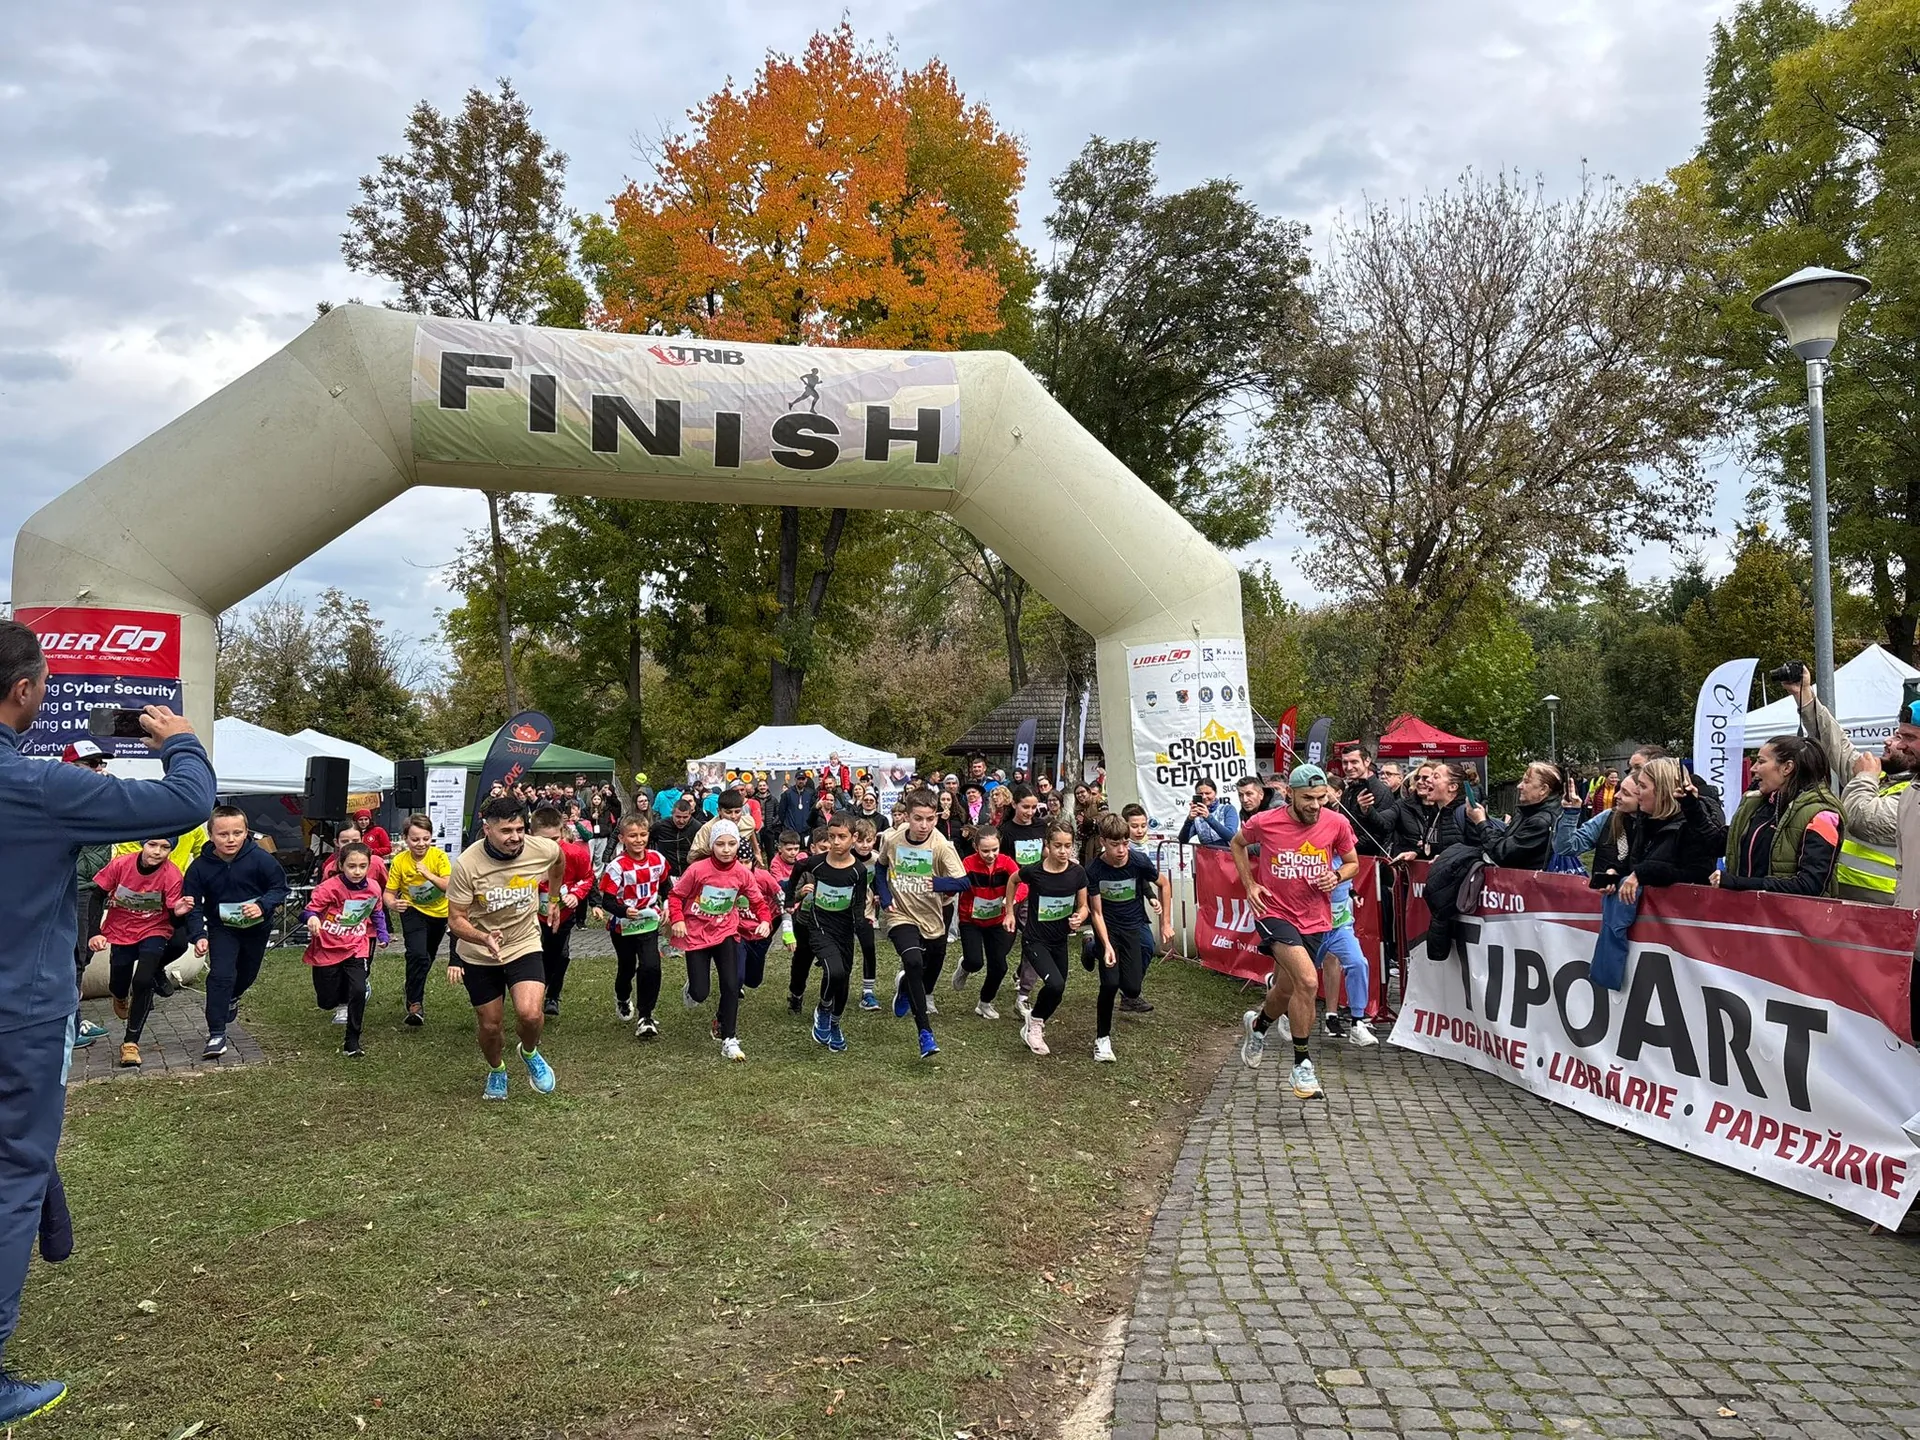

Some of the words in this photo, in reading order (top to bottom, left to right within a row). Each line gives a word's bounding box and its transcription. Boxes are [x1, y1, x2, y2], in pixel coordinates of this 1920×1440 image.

[674, 346, 745, 366] TRIB
[438, 350, 942, 471] FINISH
[37, 633, 101, 651] IDER
[1133, 655, 1167, 666] LIDER
[63, 682, 110, 696] Cyber
[114, 683, 176, 700] Security
[39, 701, 59, 715] ing
[62, 702, 72, 711] a
[31, 719, 59, 733] ning
[61, 720, 71, 729] a
[506, 741, 540, 756] Sakura
[1168, 737, 1239, 764] CROSUL
[504, 762, 524, 785] OVE
[1175, 799, 1186, 807] by
[1278, 852, 1325, 867] CROSUL
[486, 883, 533, 902] CROSUL
[1212, 934, 1234, 949] Lider
[1549, 1052, 1678, 1119] LIBRĂRIE
[1704, 1100, 1907, 1200] PAPETĂRIE
